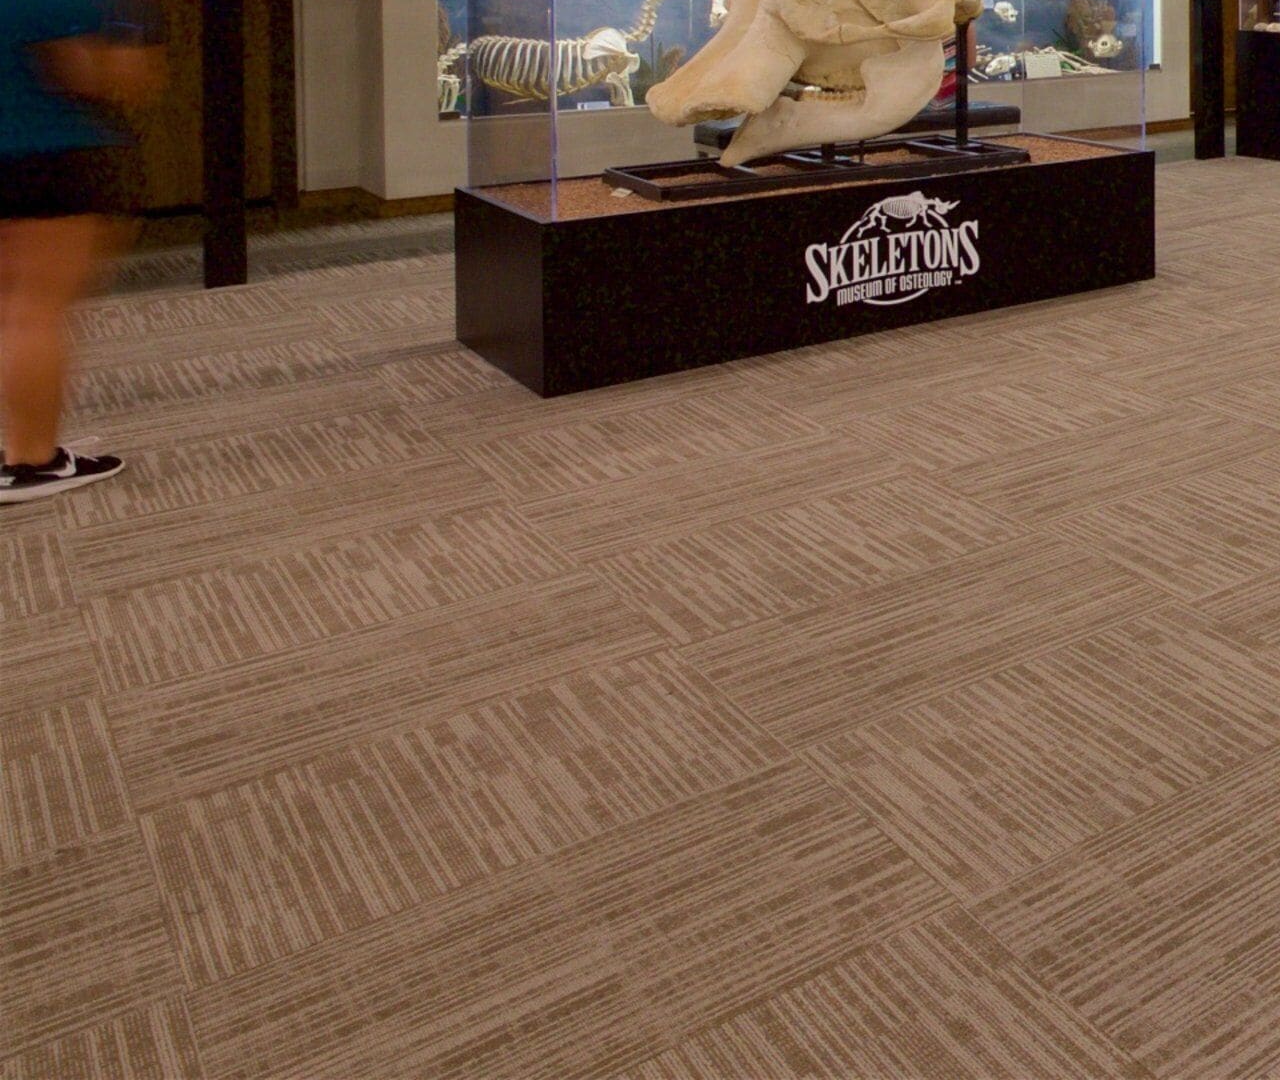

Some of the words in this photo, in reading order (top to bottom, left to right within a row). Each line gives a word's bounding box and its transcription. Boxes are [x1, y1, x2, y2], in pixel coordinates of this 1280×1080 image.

[805, 220, 981, 304] SKELETONS
[836, 280, 884, 307] MUSEUM
[885, 275, 899, 295] OF
[900, 270, 953, 291] OSTEOLOGY
